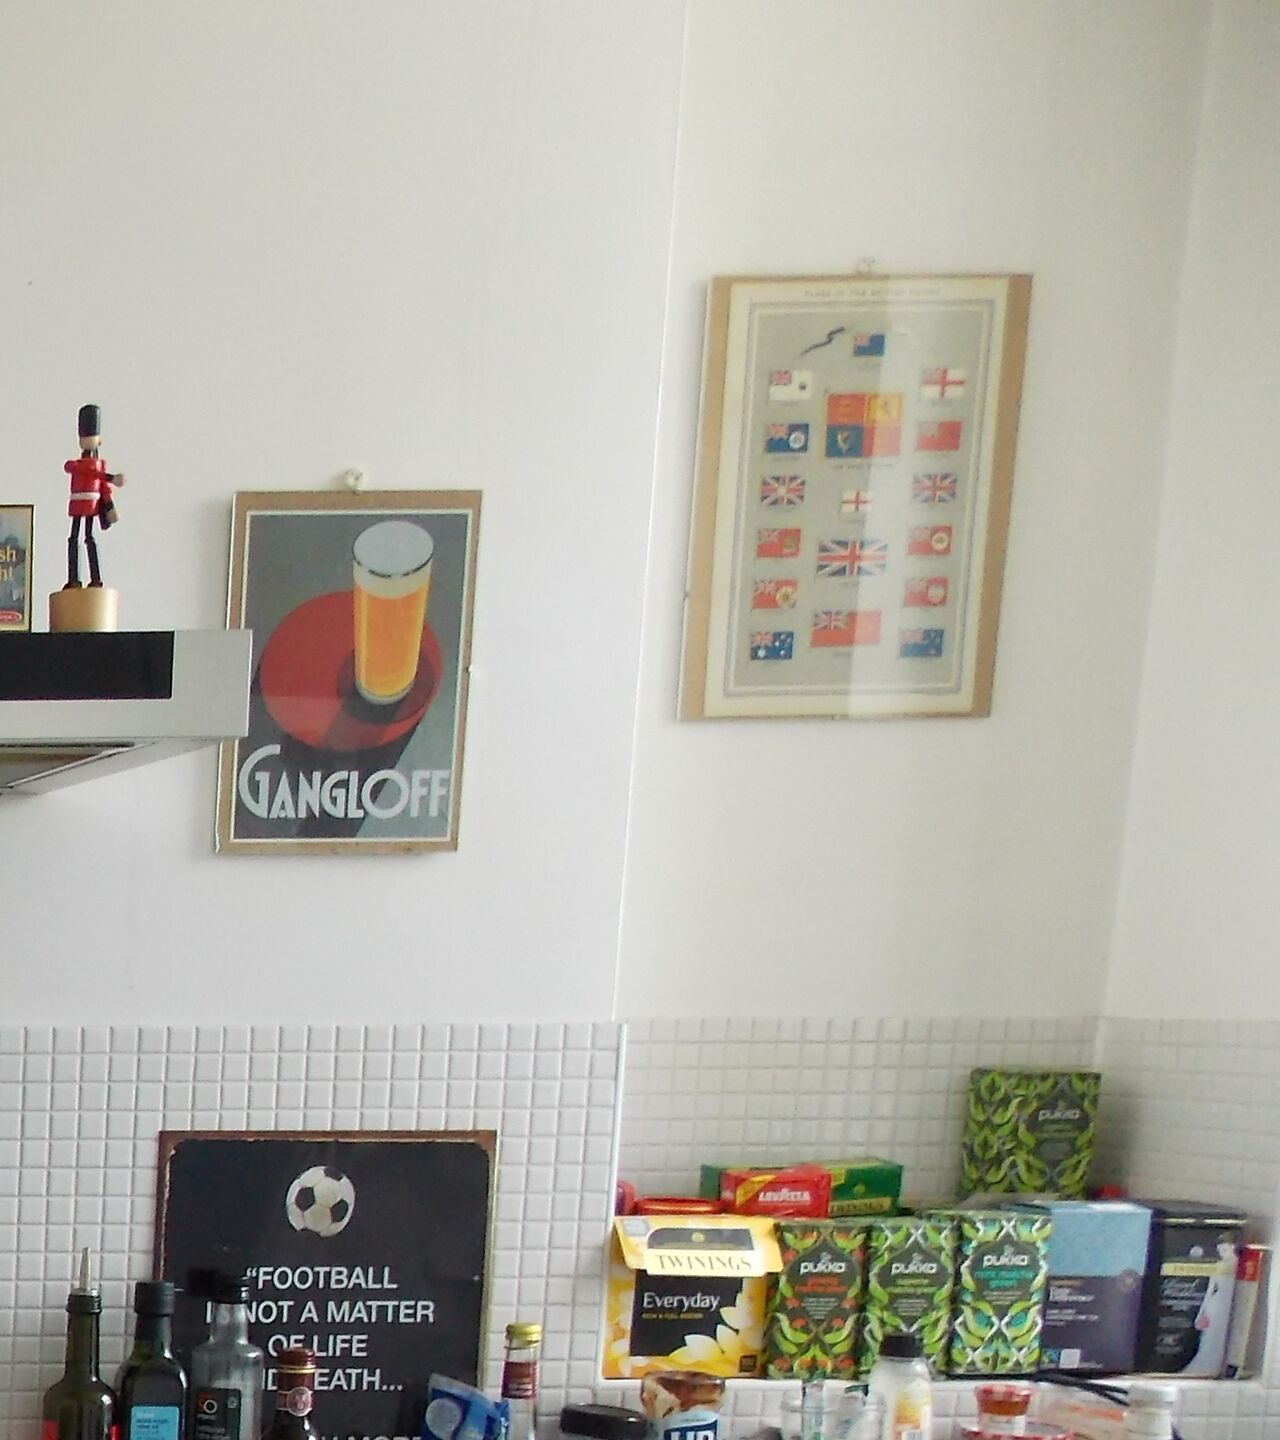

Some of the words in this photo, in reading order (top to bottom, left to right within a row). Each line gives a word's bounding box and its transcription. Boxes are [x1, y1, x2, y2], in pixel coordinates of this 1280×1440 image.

[238, 743, 451, 819] GANGLOFF
[1038, 1108, 1081, 1121] pukka
[654, 1254, 752, 1271] TWININGS
[800, 1260, 846, 1276] pukka
[891, 1259, 938, 1275] pukka
[982, 1252, 1030, 1269] pukka
[642, 1291, 721, 1312] Everyday
[241, 1301, 294, 1324] NOT
[300, 1302, 319, 1323] A
[326, 1301, 435, 1324] MATTER
[268, 1335, 305, 1357] OF
[314, 1335, 369, 1357] LIFE
[314, 1369, 404, 1391] EATH...
